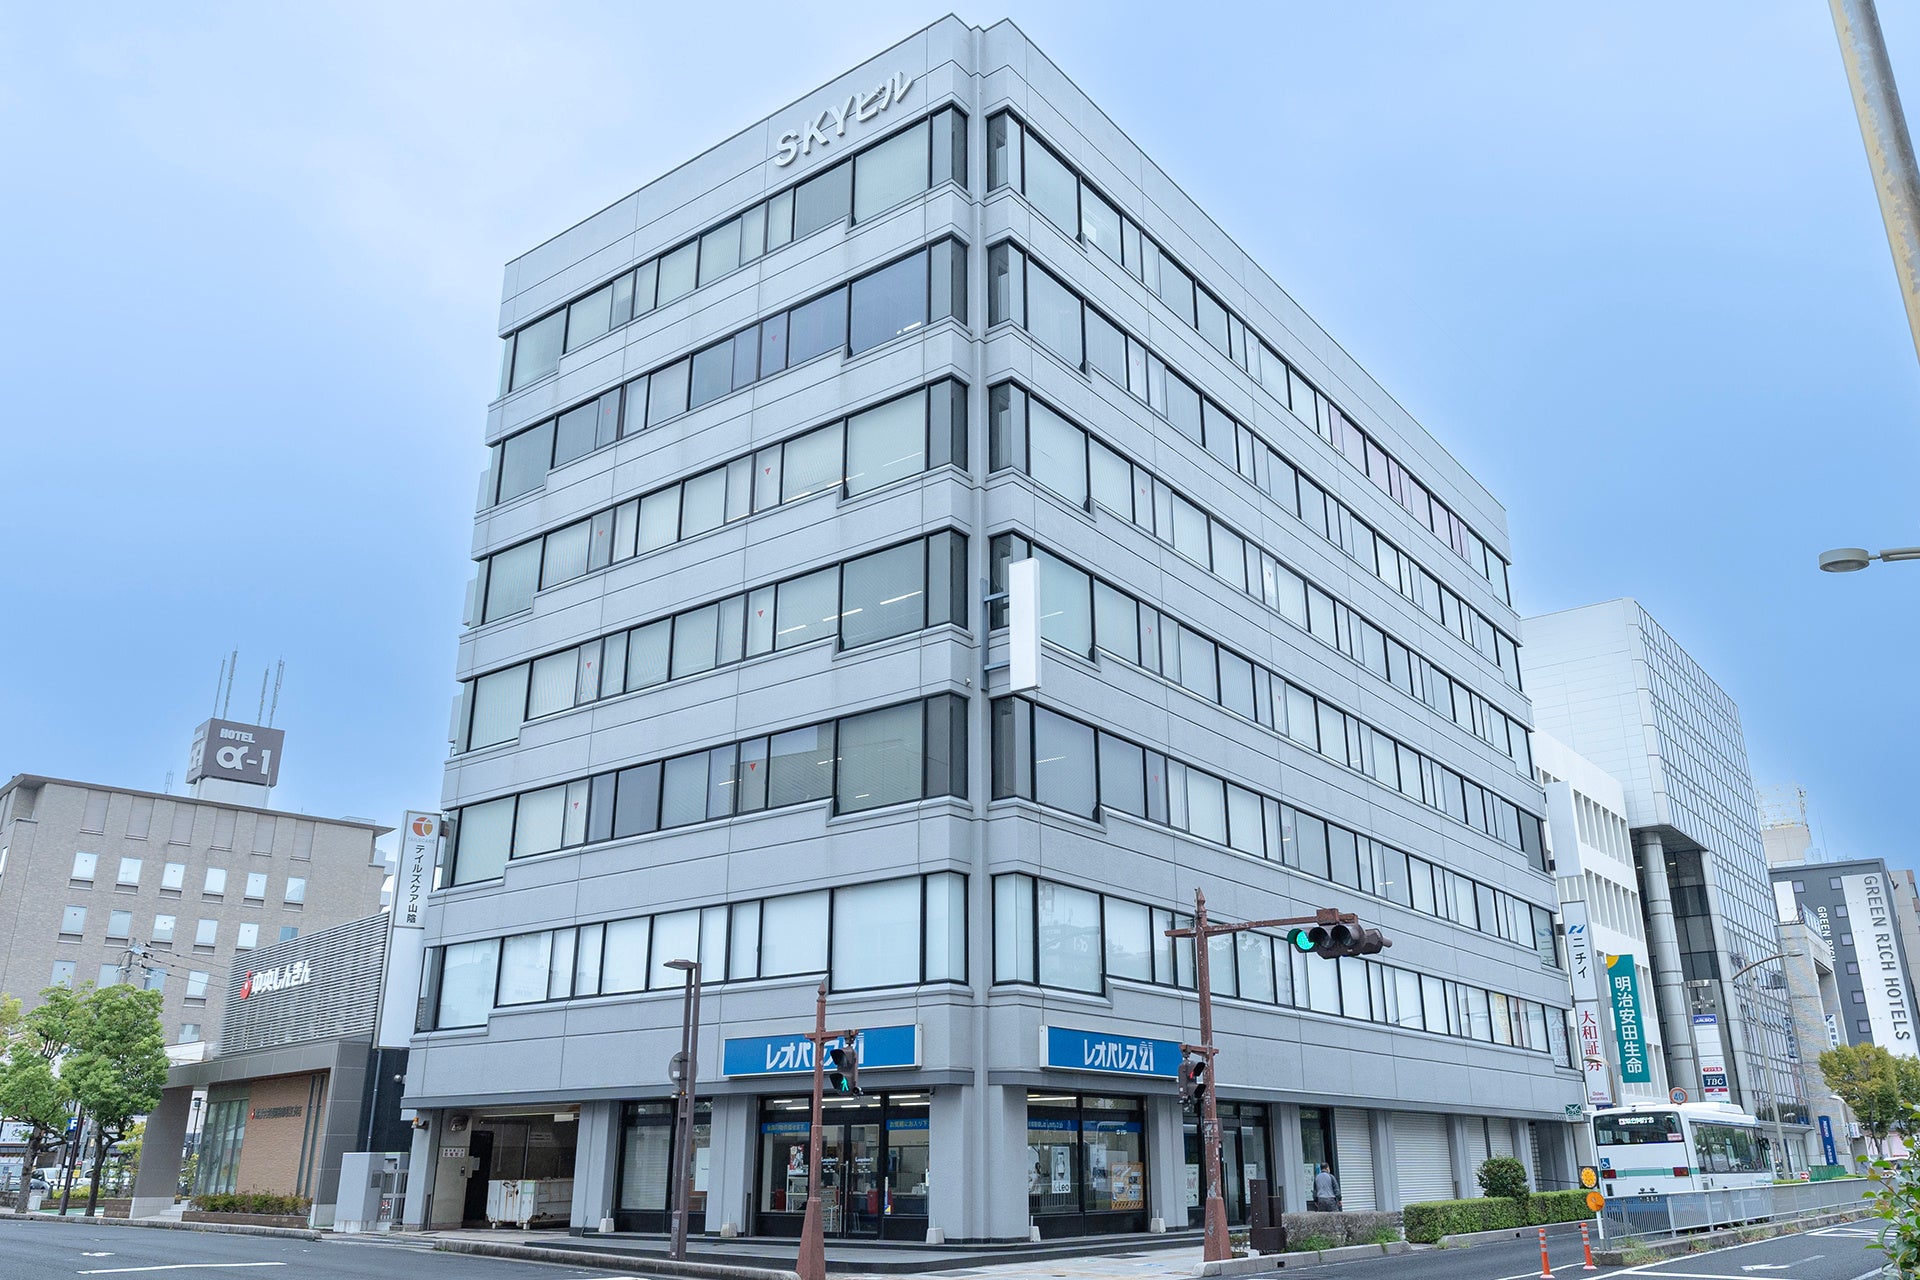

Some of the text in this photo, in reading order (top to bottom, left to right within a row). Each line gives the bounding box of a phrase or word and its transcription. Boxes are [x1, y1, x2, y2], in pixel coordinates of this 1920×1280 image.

[774, 71, 914, 167] SKYビル
[220, 728, 256, 743] HOTEL
[1817, 906, 1831, 937] GREEN
[251, 960, 312, 994] 中央しんきん
[1572, 937, 1587, 979] ニチイ
[1863, 875, 1911, 1041] GREEN RICH HOTELS
[1580, 1010, 1603, 1072] 大和証券
[1614, 976, 1643, 1074] 明治安田生命
[1083, 1039, 1154, 1071] レオパレス21
[1706, 1077, 1724, 1086] TBC
